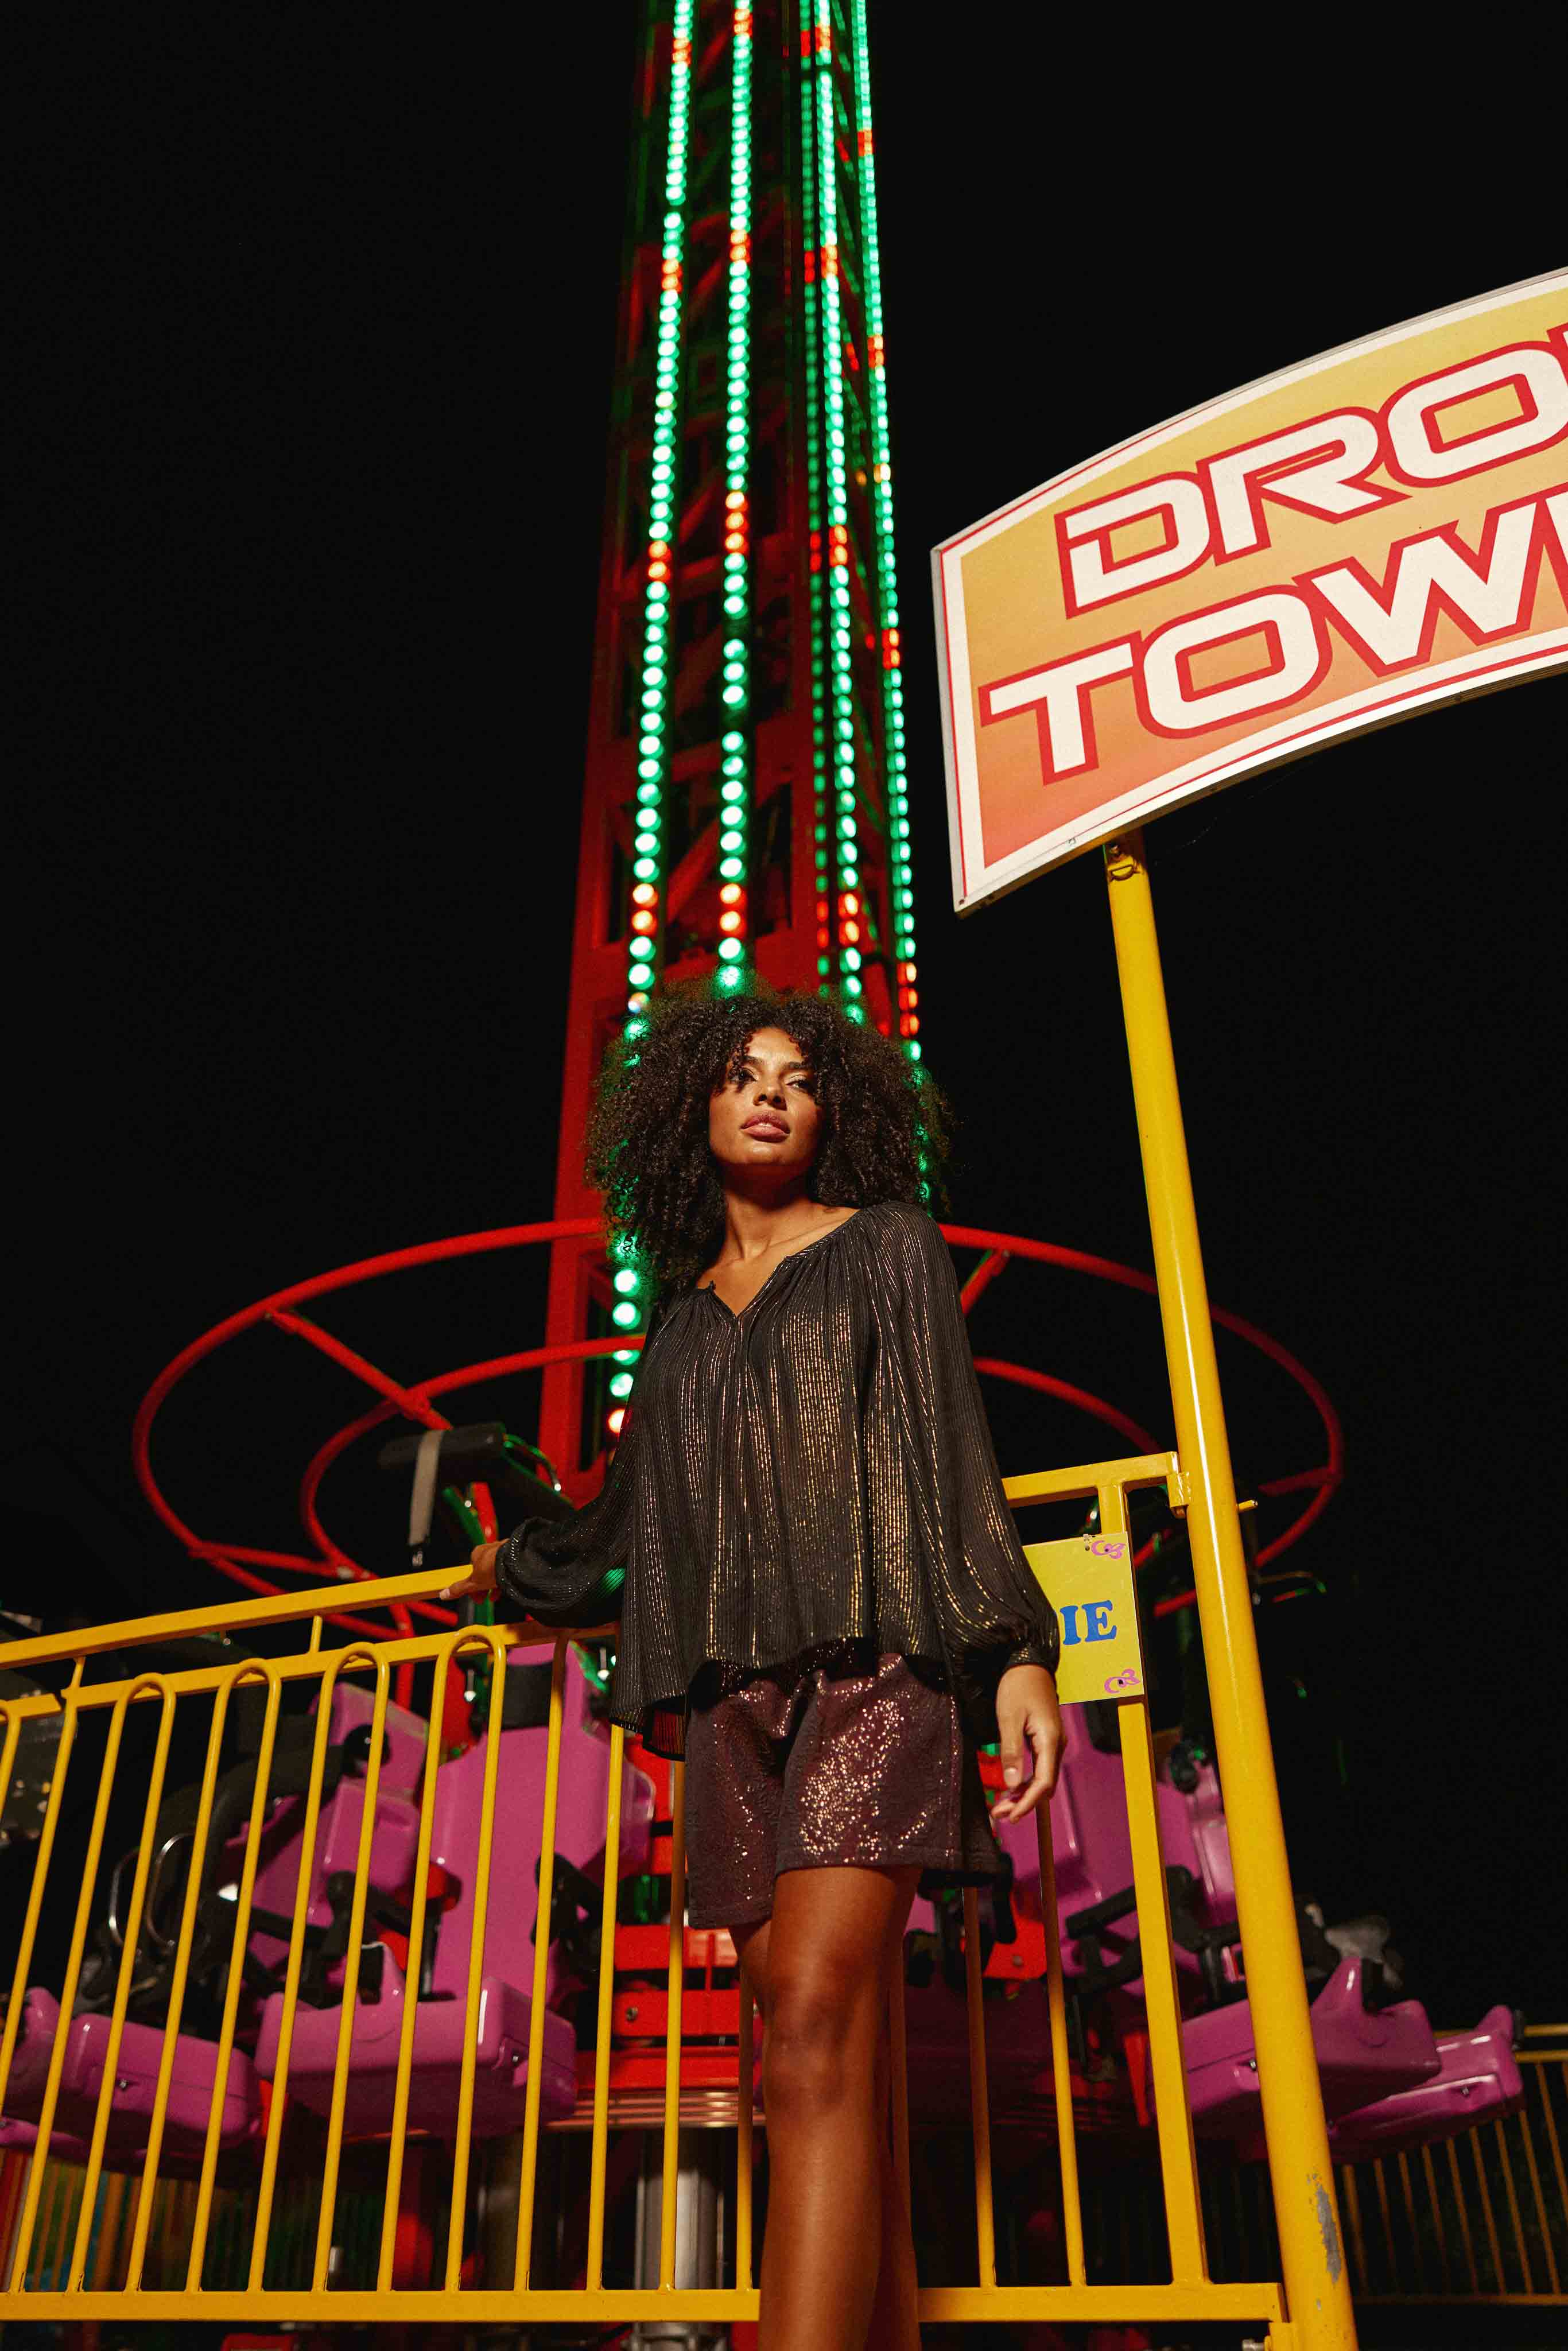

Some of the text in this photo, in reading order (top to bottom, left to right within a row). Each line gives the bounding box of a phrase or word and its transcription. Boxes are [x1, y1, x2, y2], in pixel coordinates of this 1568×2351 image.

[1054, 322, 1568, 619] DRO
[978, 482, 1568, 785] TOW
[1059, 1600, 1117, 1646] IE
